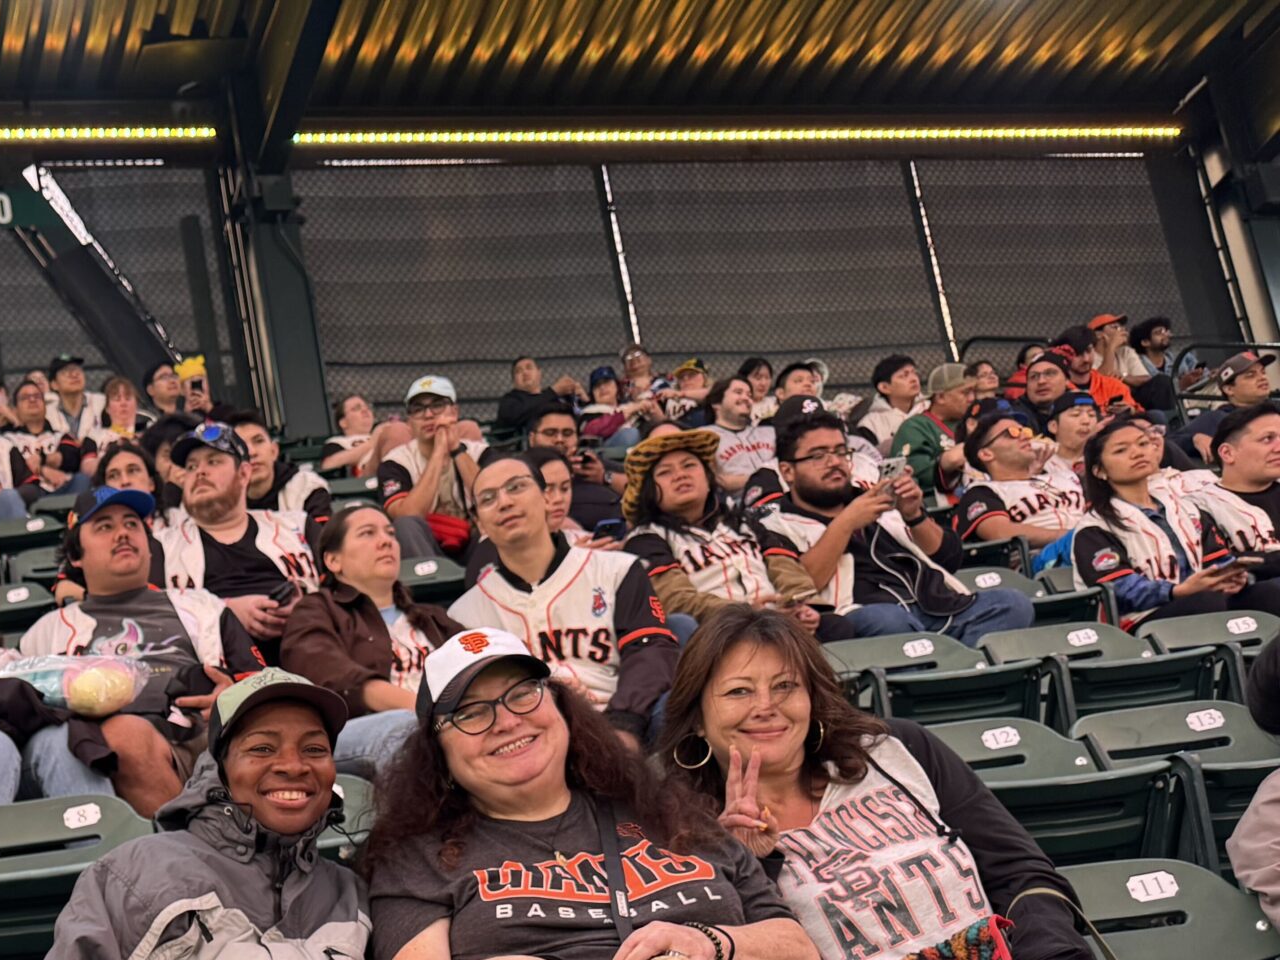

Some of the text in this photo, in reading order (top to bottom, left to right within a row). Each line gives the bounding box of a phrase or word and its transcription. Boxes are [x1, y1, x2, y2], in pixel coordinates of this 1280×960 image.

[1236, 620, 1251, 630] 15
[458, 631, 490, 654] SF
[538, 627, 612, 663] NTS
[1075, 631, 1091, 643] 14
[910, 641, 927, 655] 13
[1195, 712, 1217, 728] 13
[991, 729, 1013, 746] 12
[76, 809, 87, 824] 8
[1138, 876, 1167, 897] 11
[495, 886, 722, 919] BASEALL
